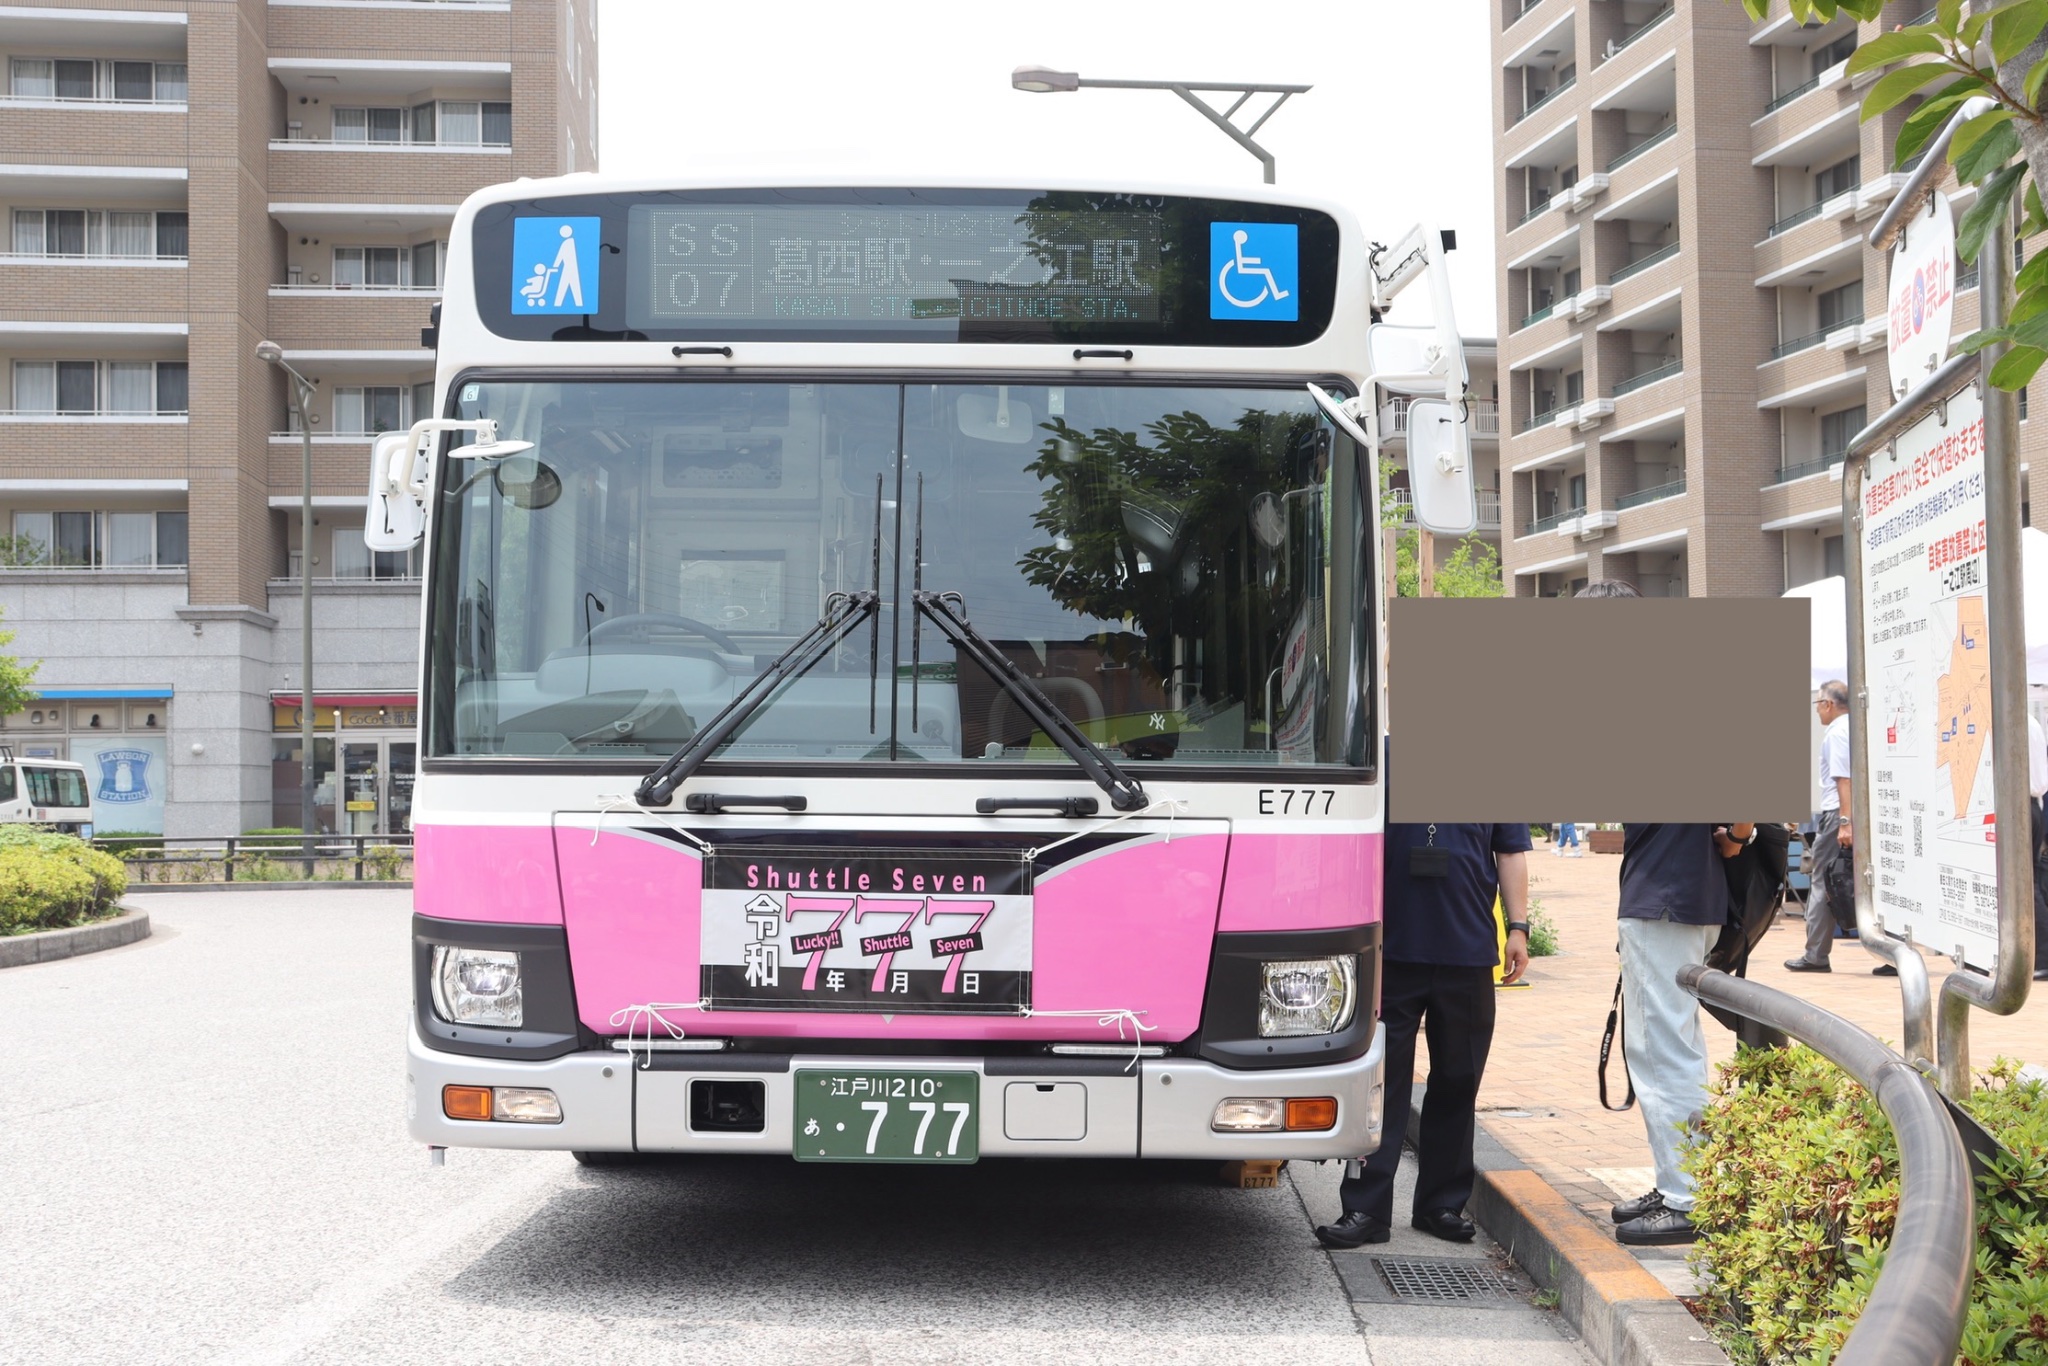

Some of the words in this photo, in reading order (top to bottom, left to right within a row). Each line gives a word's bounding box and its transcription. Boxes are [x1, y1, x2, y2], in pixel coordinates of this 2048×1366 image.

[669, 223, 738, 256] SS
[669, 271, 738, 307] 07
[1925, 245, 1950, 319] 禁止
[775, 296, 850, 316] KASAI
[957, 297, 1064, 317] ICHINOE
[100, 751, 148, 763] LAWSON
[100, 789, 148, 801] STATION
[1259, 789, 1336, 815] E777
[746, 865, 871, 890] Shuttle
[892, 868, 986, 892] Seven
[744, 893, 782, 988] 令和
[794, 931, 841, 952] Lucky!!
[863, 933, 911, 952] Shuttle
[936, 937, 975, 954] Seven
[803, 1117, 821, 1137] あ
